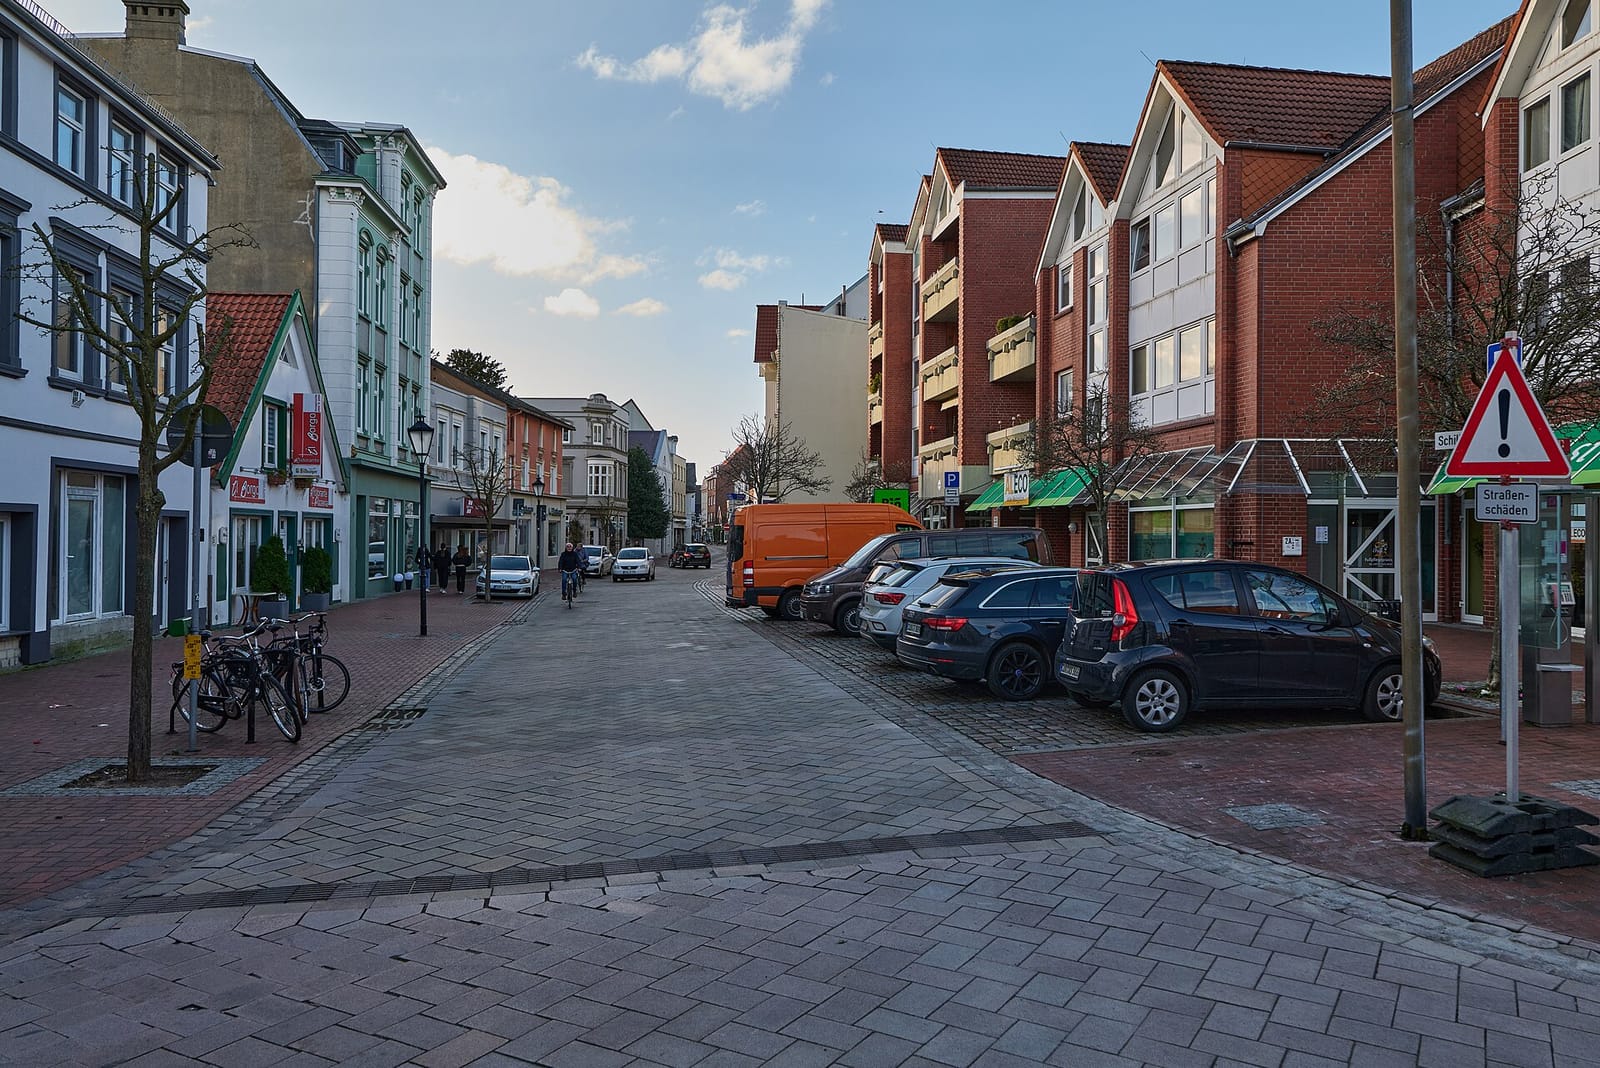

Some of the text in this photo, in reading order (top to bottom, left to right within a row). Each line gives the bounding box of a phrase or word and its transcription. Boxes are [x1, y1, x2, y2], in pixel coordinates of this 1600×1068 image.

[306, 412, 319, 442] Borgo
[947, 473, 957, 486] P
[1483, 489, 1530, 501] Straßen-
[1484, 504, 1528, 516] schäden
